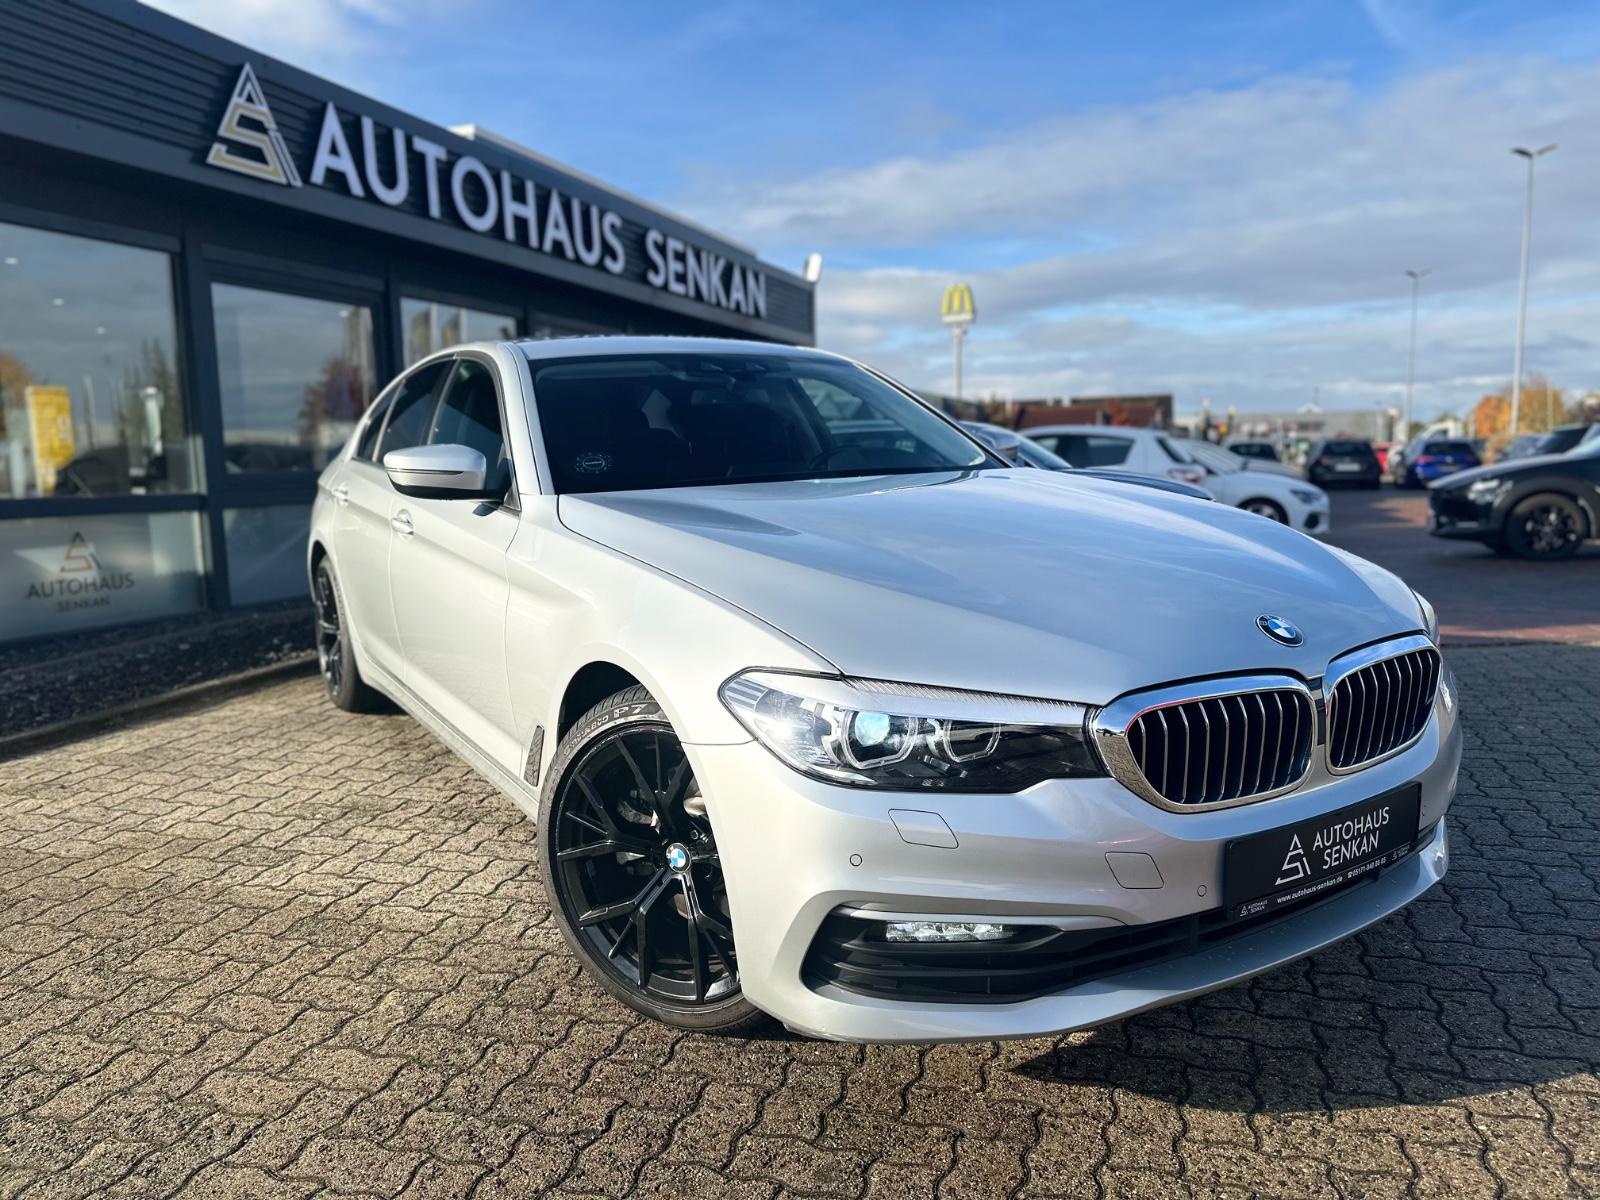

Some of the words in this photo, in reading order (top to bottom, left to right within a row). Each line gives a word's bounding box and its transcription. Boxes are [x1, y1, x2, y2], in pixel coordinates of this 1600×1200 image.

[310, 101, 626, 274] AUTOHAUS
[645, 229, 768, 319] SENKAN
[27, 572, 135, 599] AUTOHAUS
[613, 703, 648, 719] P7
[1312, 806, 1390, 851] AUTOHAUS
[1322, 830, 1380, 870] SENKAN
[1277, 876, 1343, 904] www.autohaus-senkan.de
